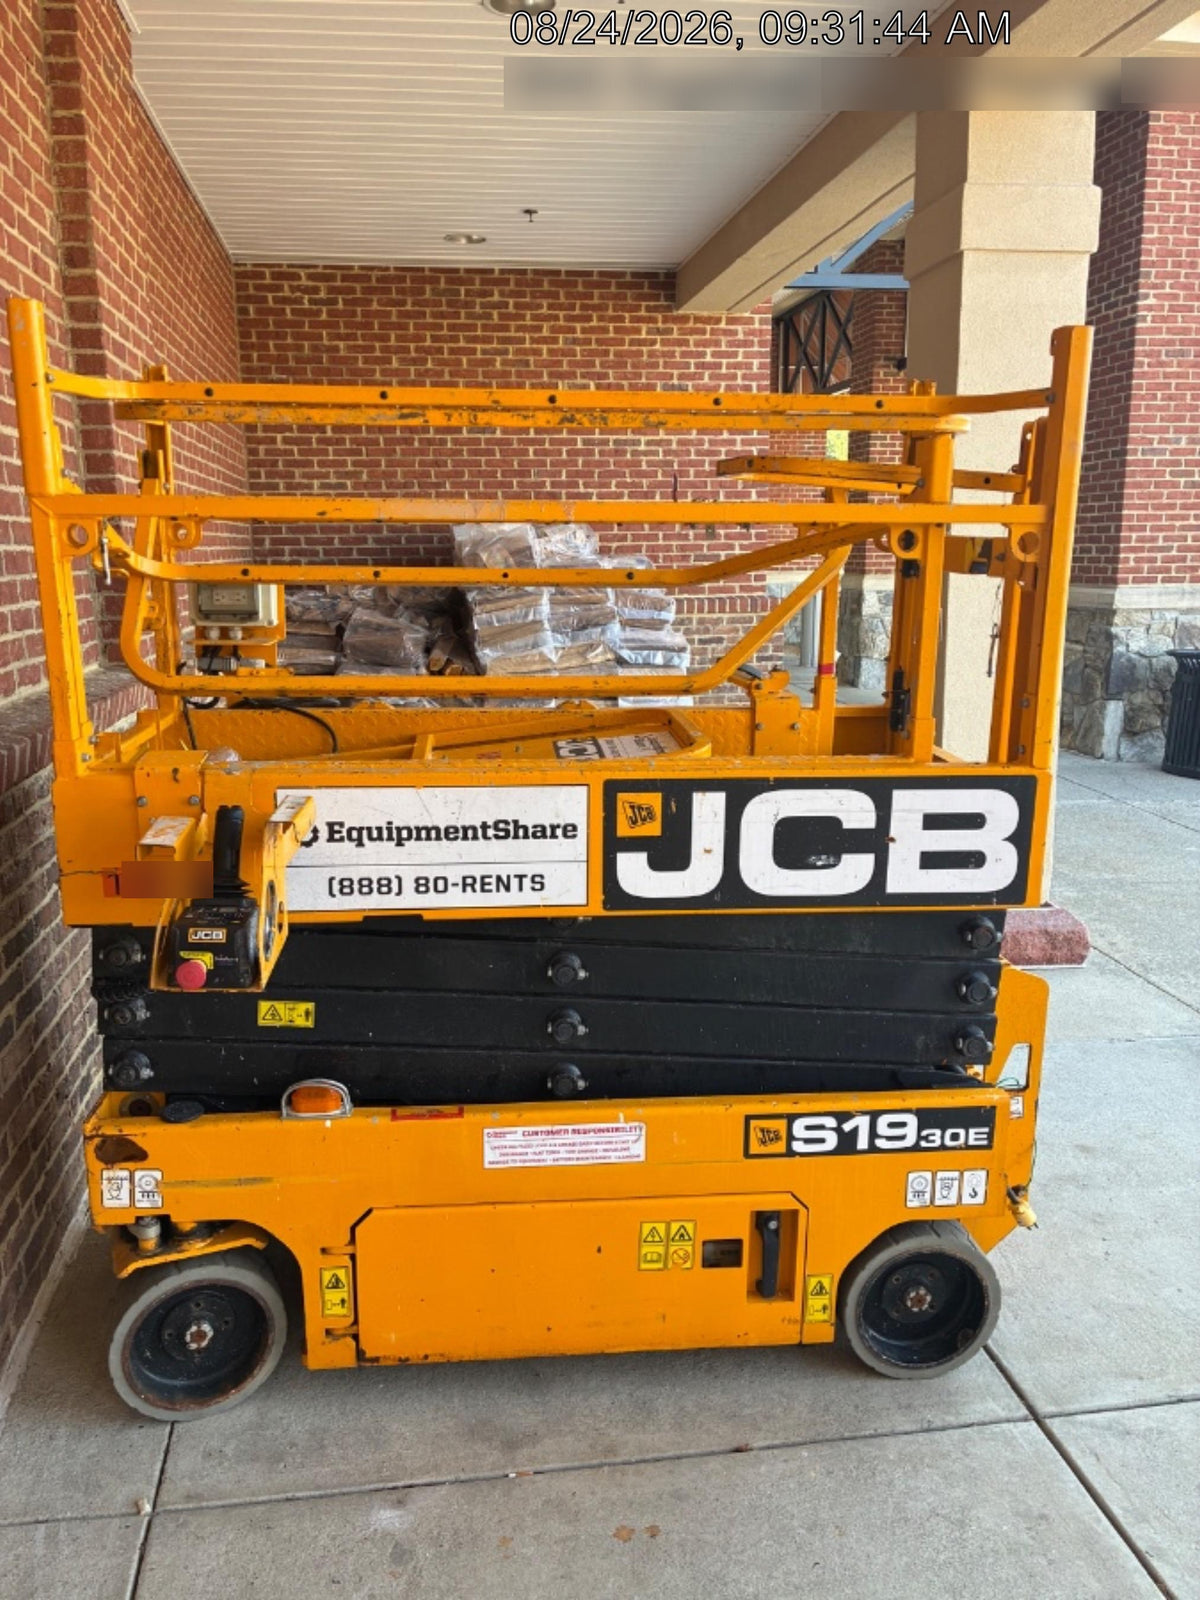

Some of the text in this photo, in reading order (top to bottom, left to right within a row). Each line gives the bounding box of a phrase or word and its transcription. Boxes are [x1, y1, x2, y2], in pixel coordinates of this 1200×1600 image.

[627, 803, 656, 826] JCB
[325, 819, 578, 847] EquipmentShare
[615, 788, 1019, 899] JCB
[328, 874, 545, 898] (888) 80-RENTS
[190, 930, 223, 940] JCB
